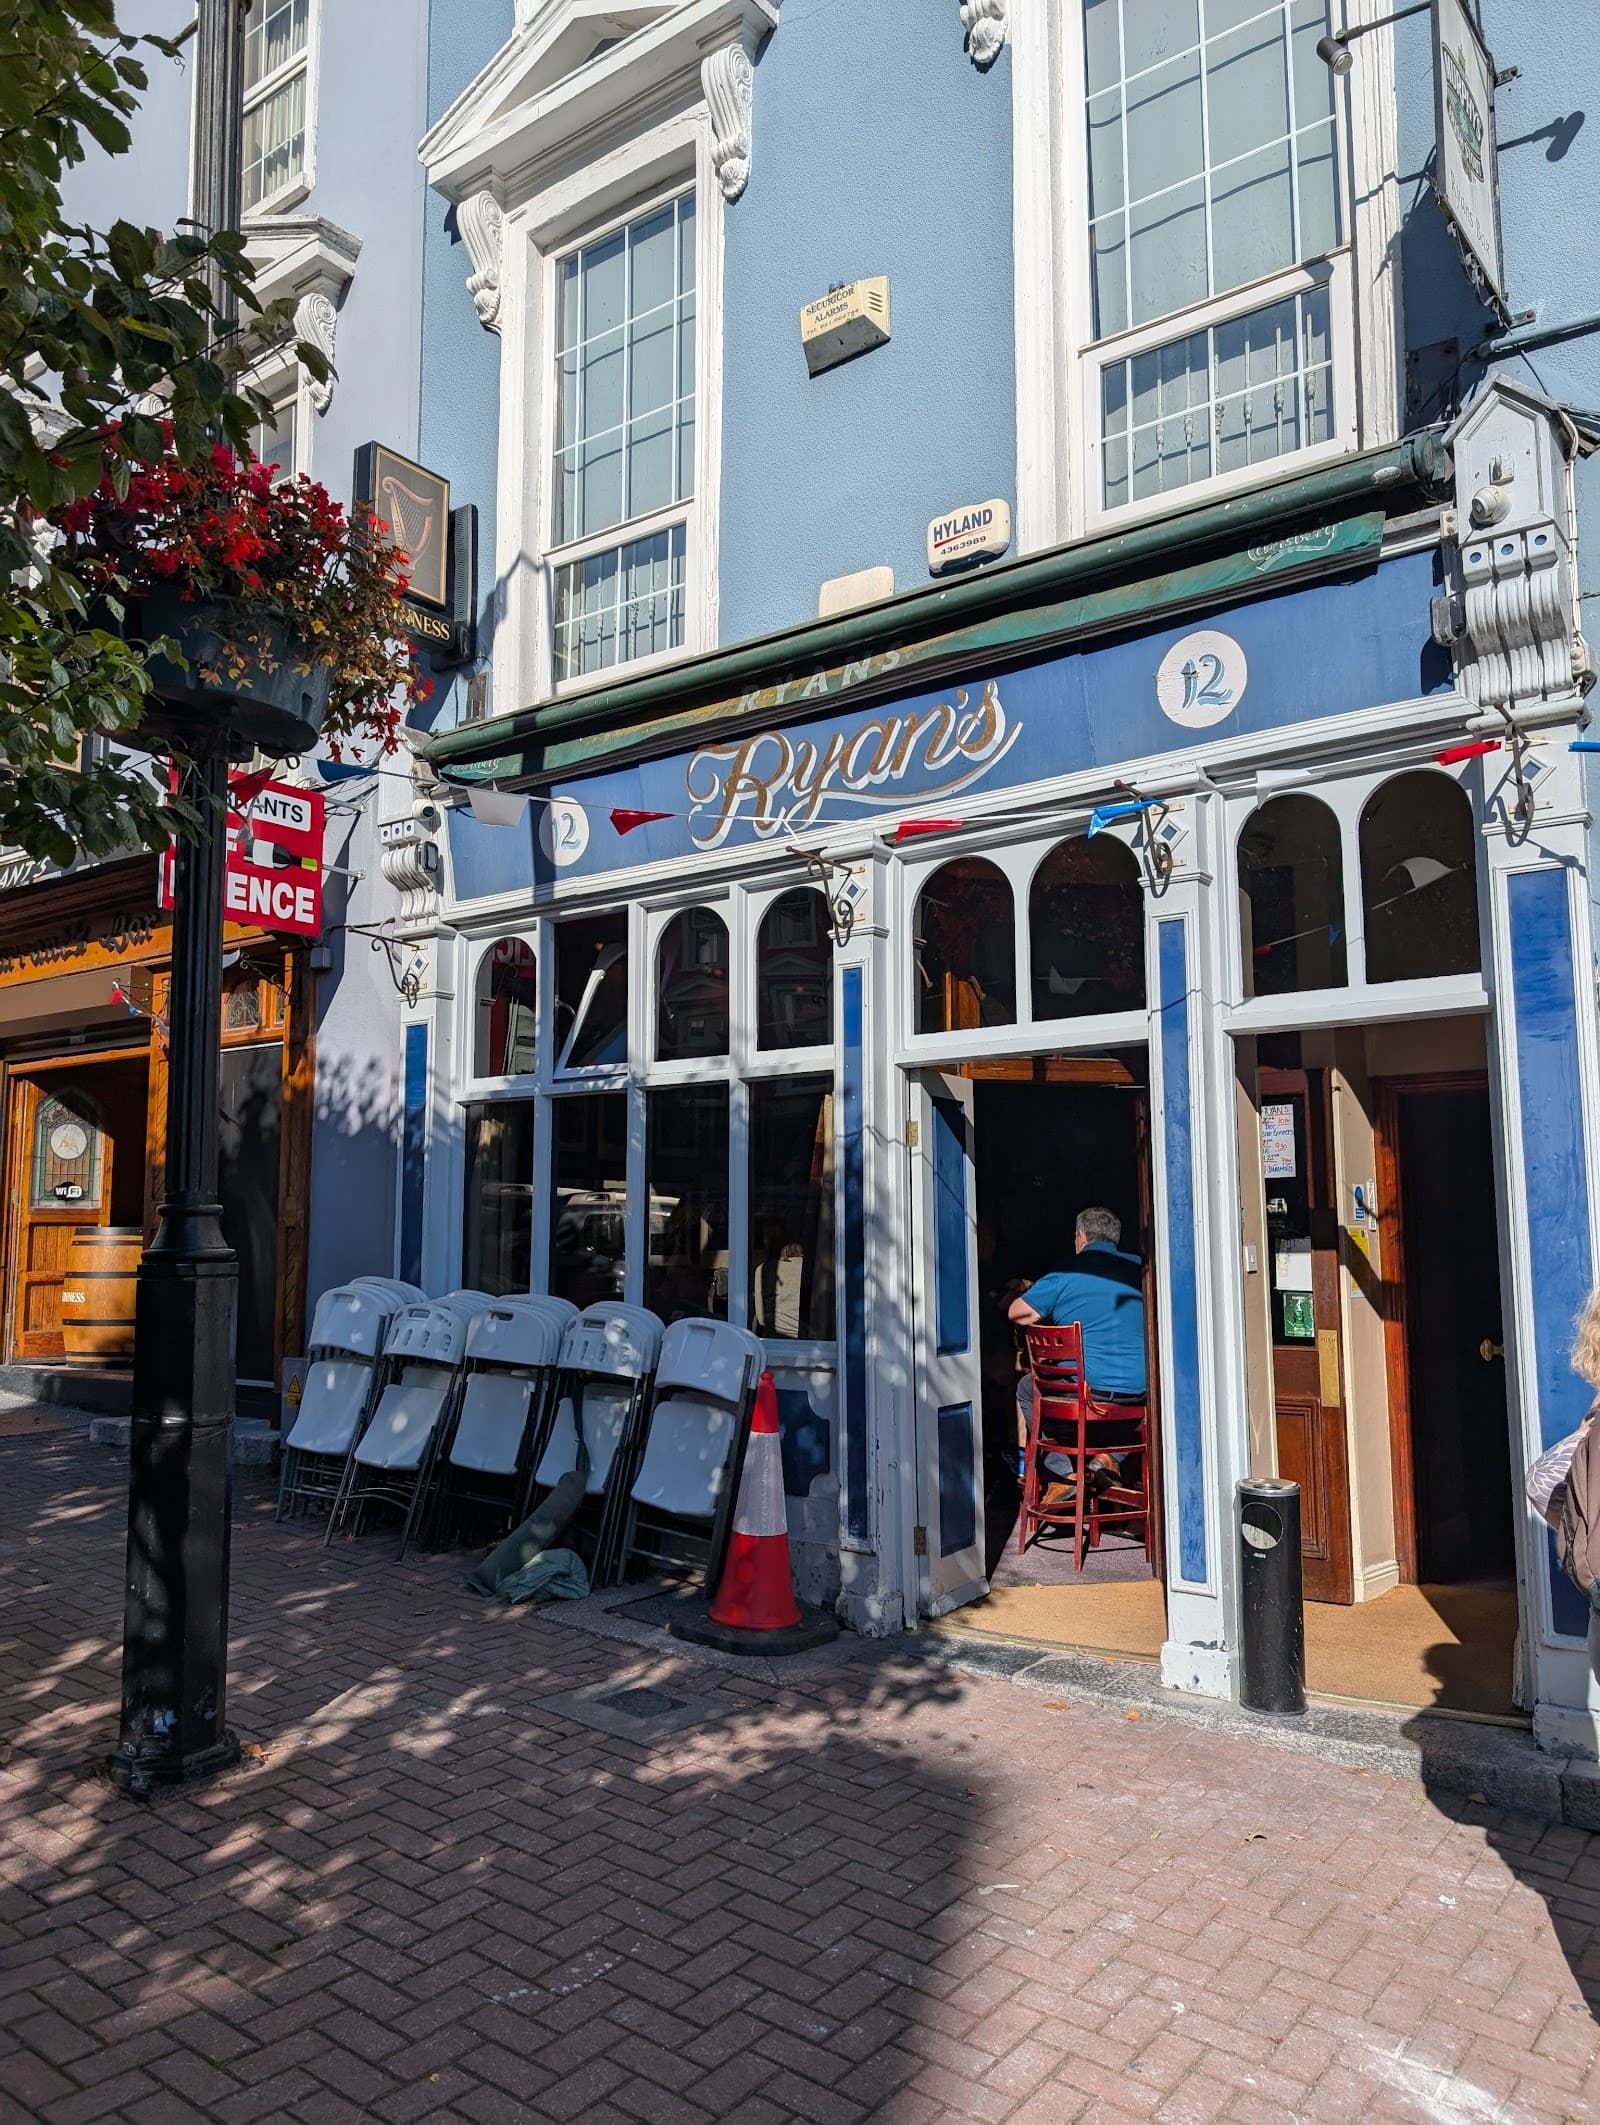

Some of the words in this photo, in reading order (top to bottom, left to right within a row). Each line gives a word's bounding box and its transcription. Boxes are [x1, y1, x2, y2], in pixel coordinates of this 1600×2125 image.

[806, 287, 854, 315] SECURICOR
[814, 301, 848, 323] ALARMS
[933, 508, 993, 542] HYLAND
[940, 535, 987, 555] 4363989
[1180, 653, 1234, 709] 12
[687, 679, 1023, 850] Ryan's
